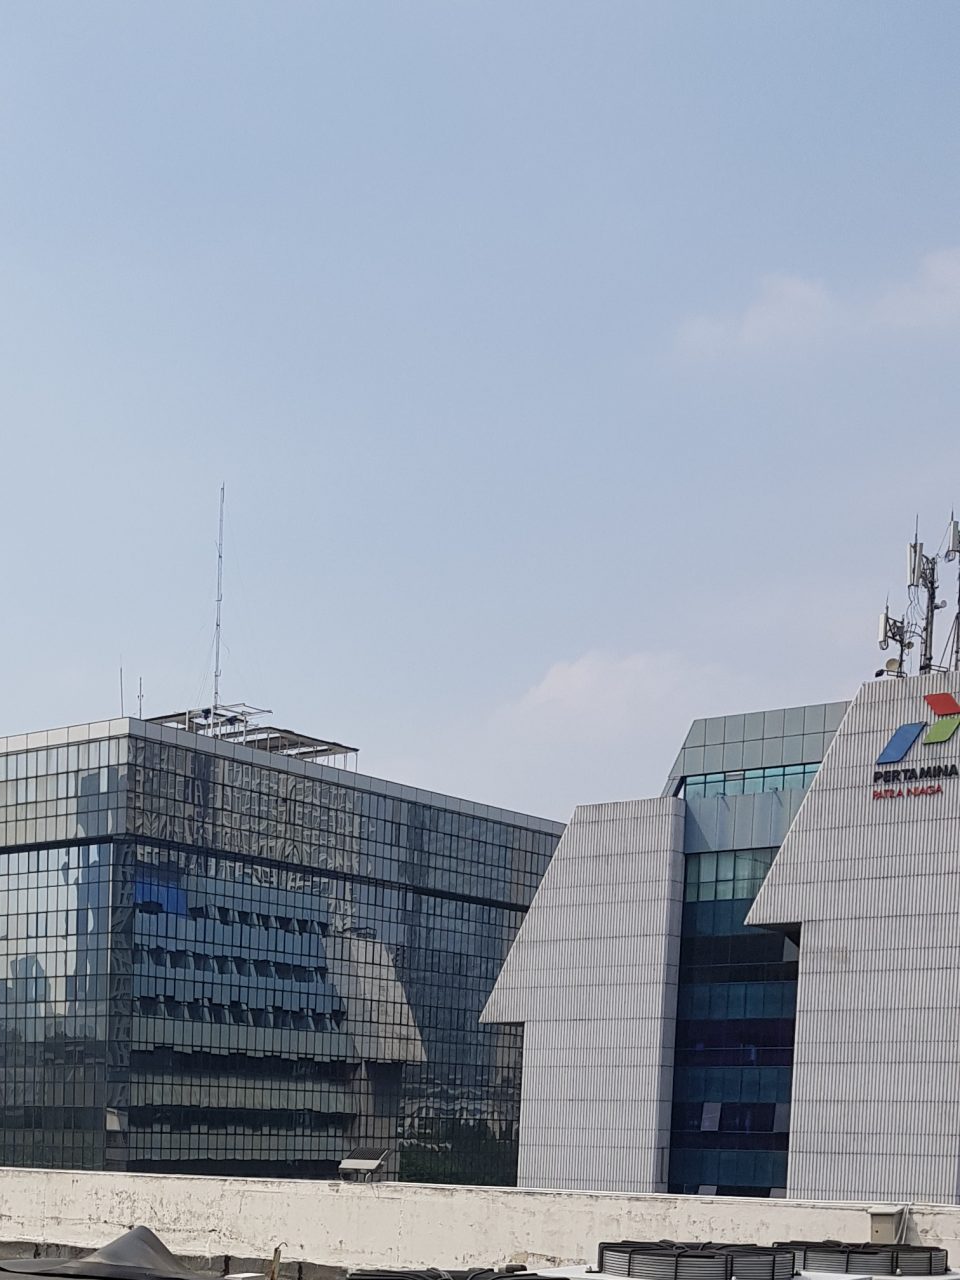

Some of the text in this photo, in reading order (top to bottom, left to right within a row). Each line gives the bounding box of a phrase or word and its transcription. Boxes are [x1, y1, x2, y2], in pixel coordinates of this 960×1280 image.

[874, 765, 959, 783] PERTAMINA
[872, 784, 944, 800] PATRA NIAGA
